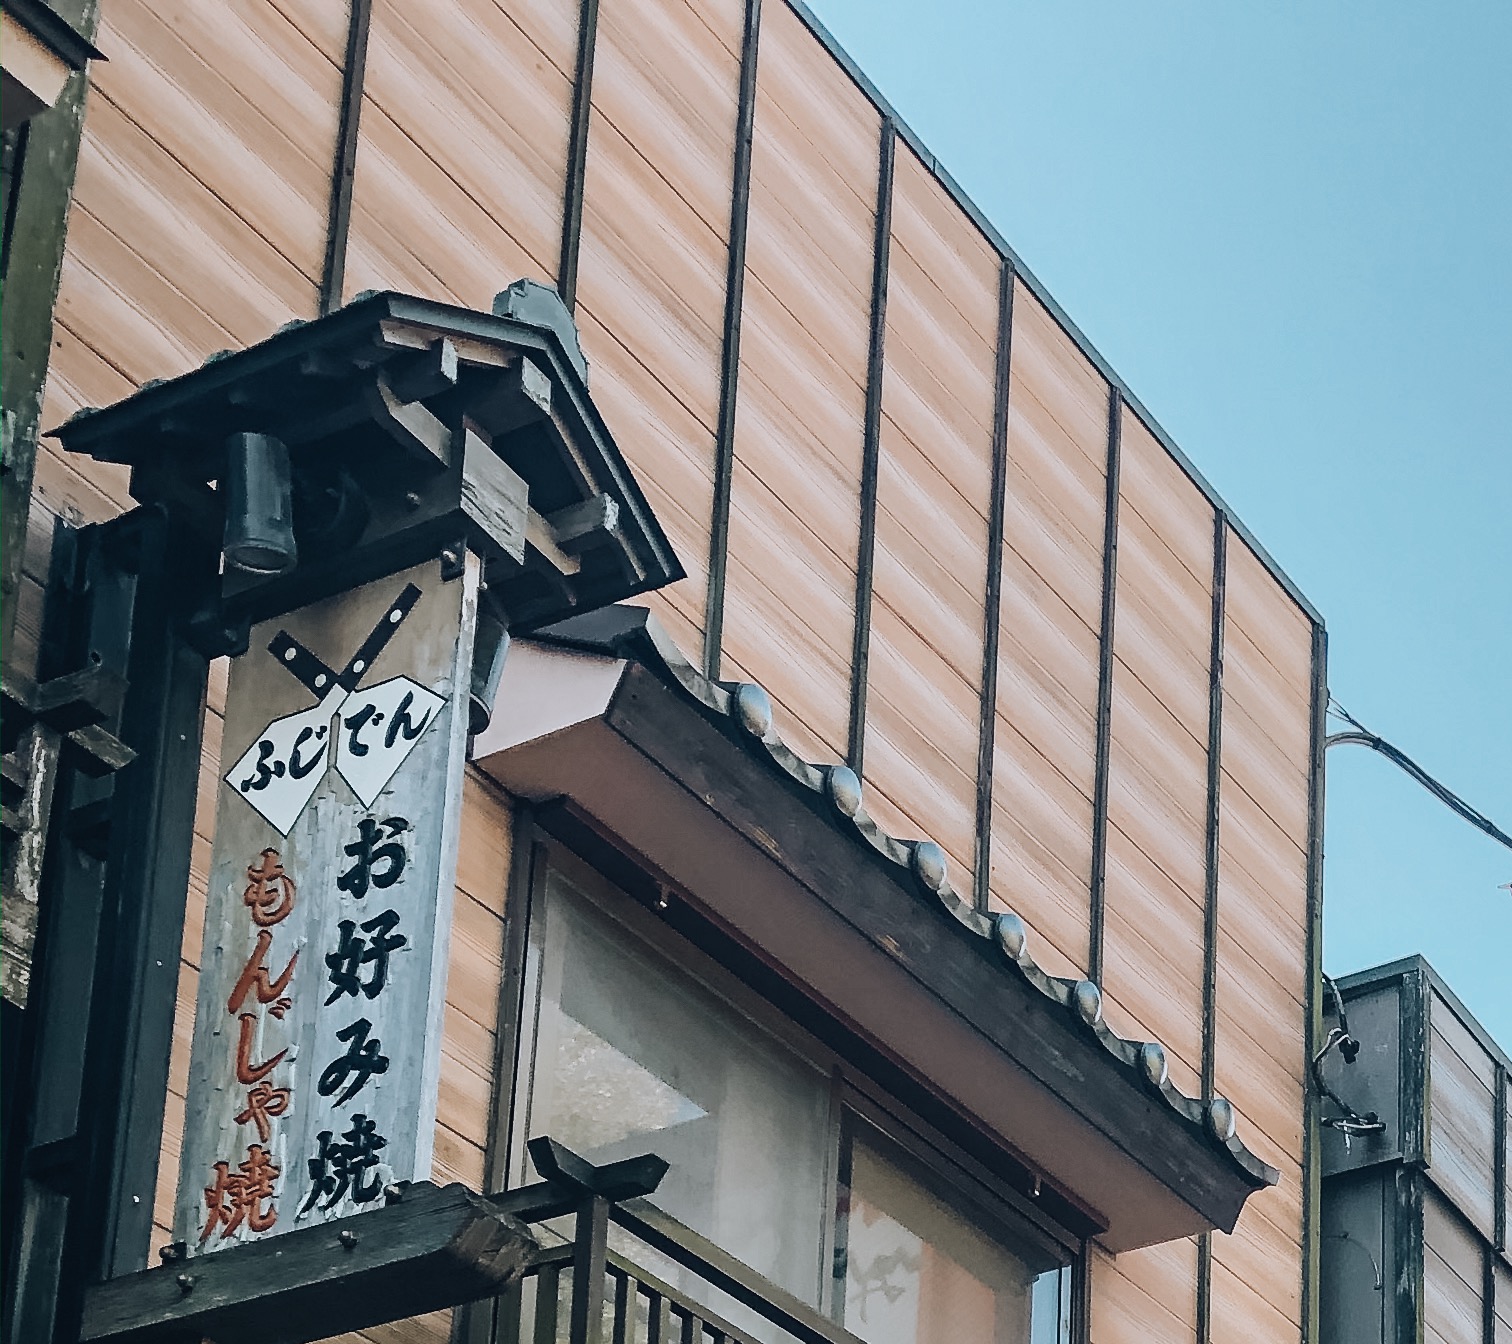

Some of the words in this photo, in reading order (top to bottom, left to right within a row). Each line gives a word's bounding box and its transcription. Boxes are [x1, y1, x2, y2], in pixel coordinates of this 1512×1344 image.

[241, 692, 431, 794] ふじでん
[296, 817, 409, 1222] お好み焼
